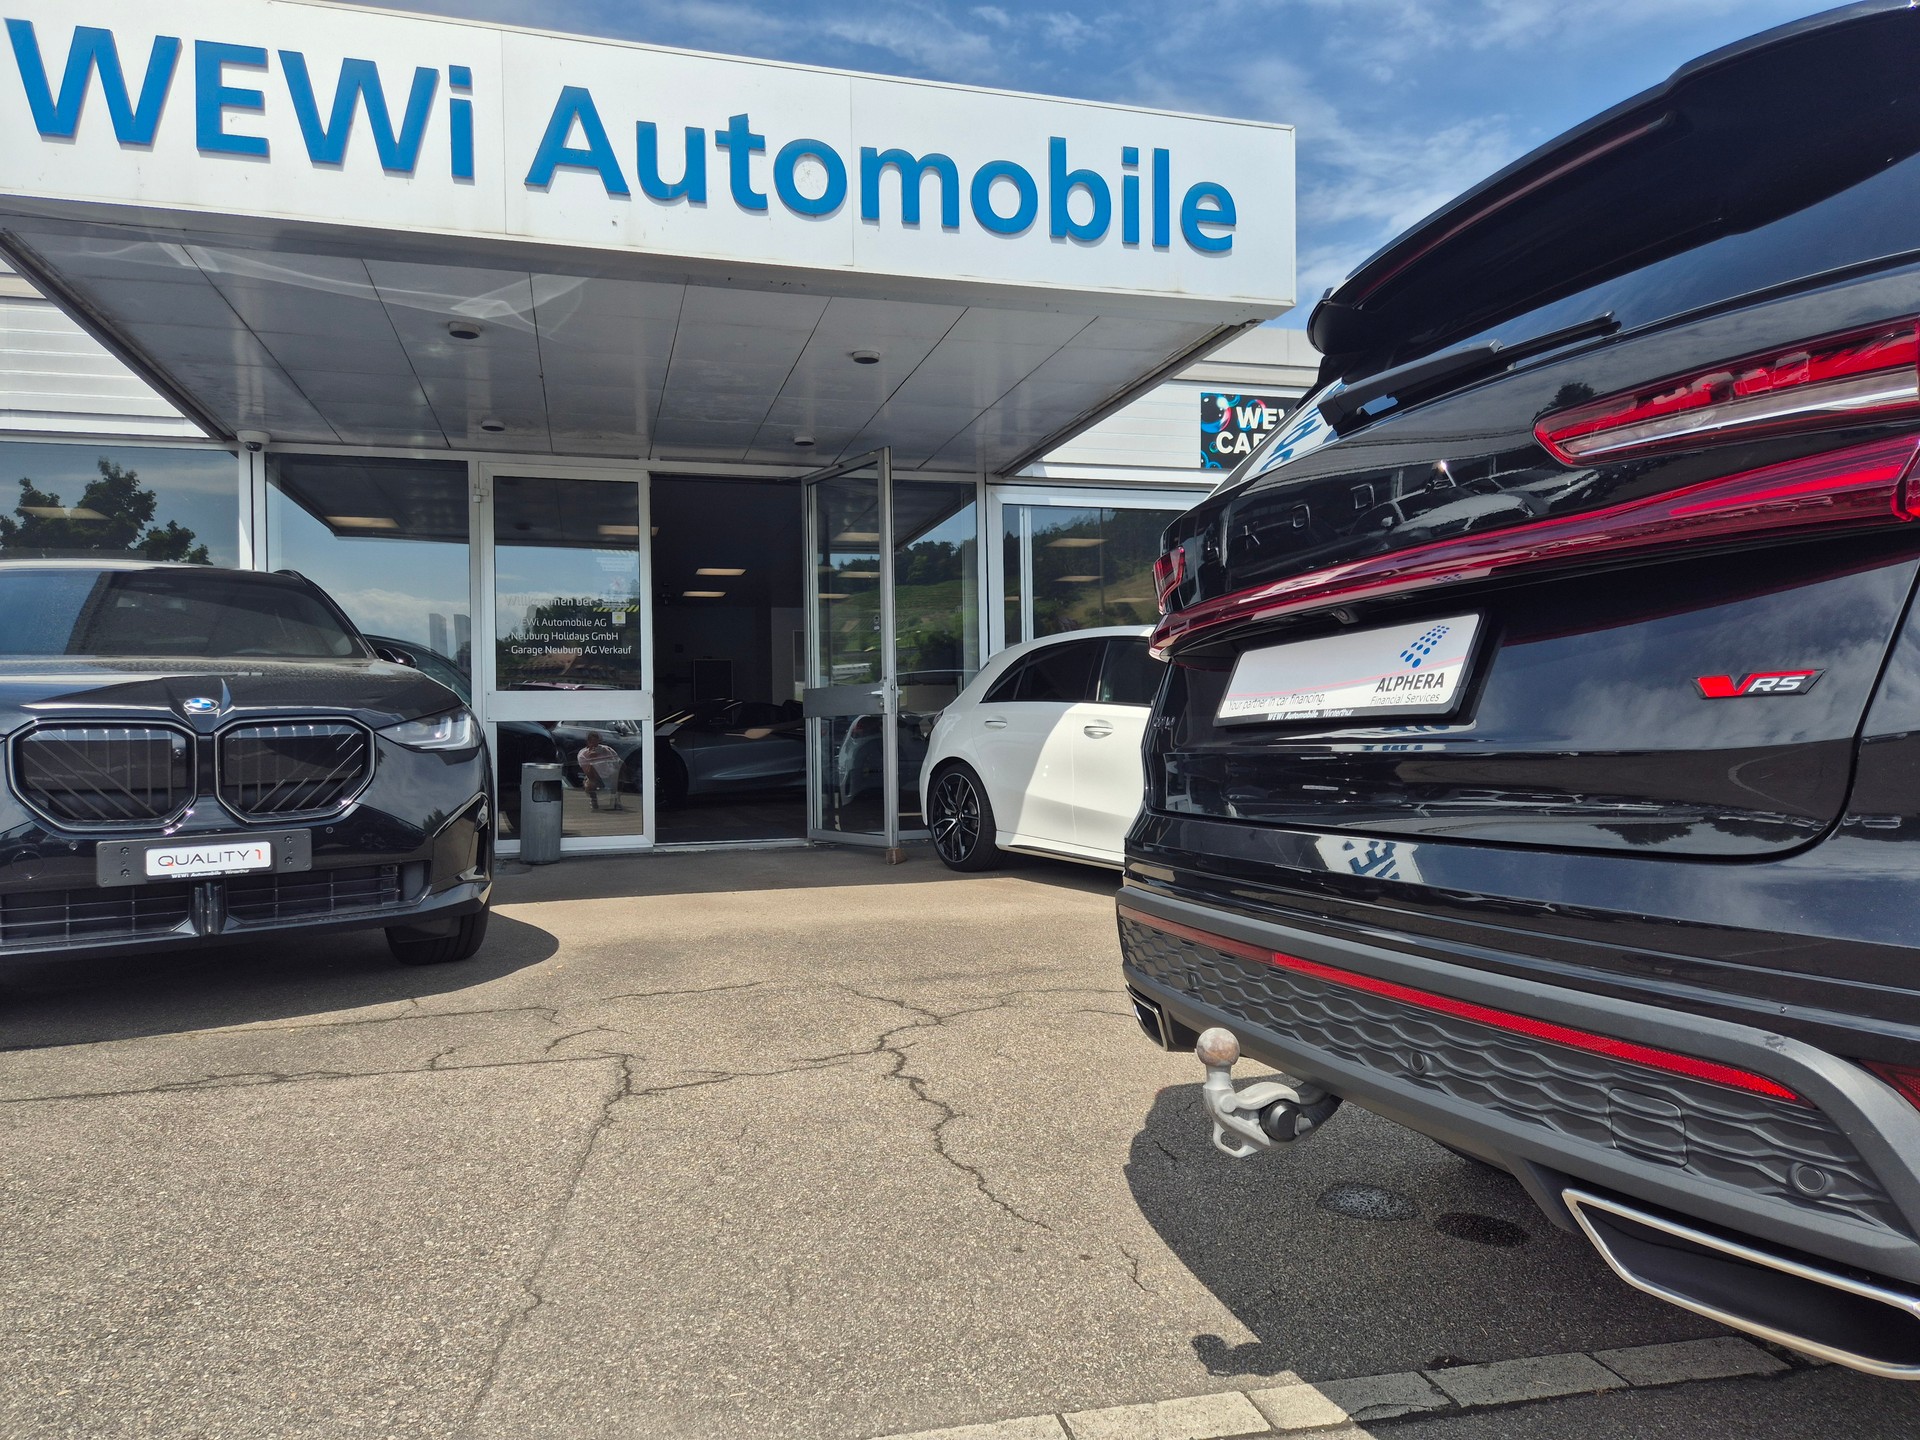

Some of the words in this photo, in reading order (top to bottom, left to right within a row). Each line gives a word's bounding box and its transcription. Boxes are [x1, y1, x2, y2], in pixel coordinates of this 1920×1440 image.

[4, 17, 475, 181] WEWi
[524, 85, 1237, 252] Automobile
[541, 617, 592, 627] Automobile
[593, 618, 607, 627] AG
[511, 632, 549, 642] Neuburg
[551, 632, 589, 642] Holidays
[591, 632, 618, 640] GmbH
[511, 645, 544, 656] Garage
[545, 645, 582, 656] Neuburg
[584, 646, 598, 654] AG
[599, 645, 632, 654] Verkauf
[1375, 672, 1445, 693] ALPHERA
[1228, 700, 1242, 711] Your
[1242, 698, 1267, 711] partner
[1276, 698, 1289, 706] car
[1370, 694, 1404, 705] Financial
[1405, 692, 1441, 703] Services
[1284, 710, 1319, 720] Automobile
